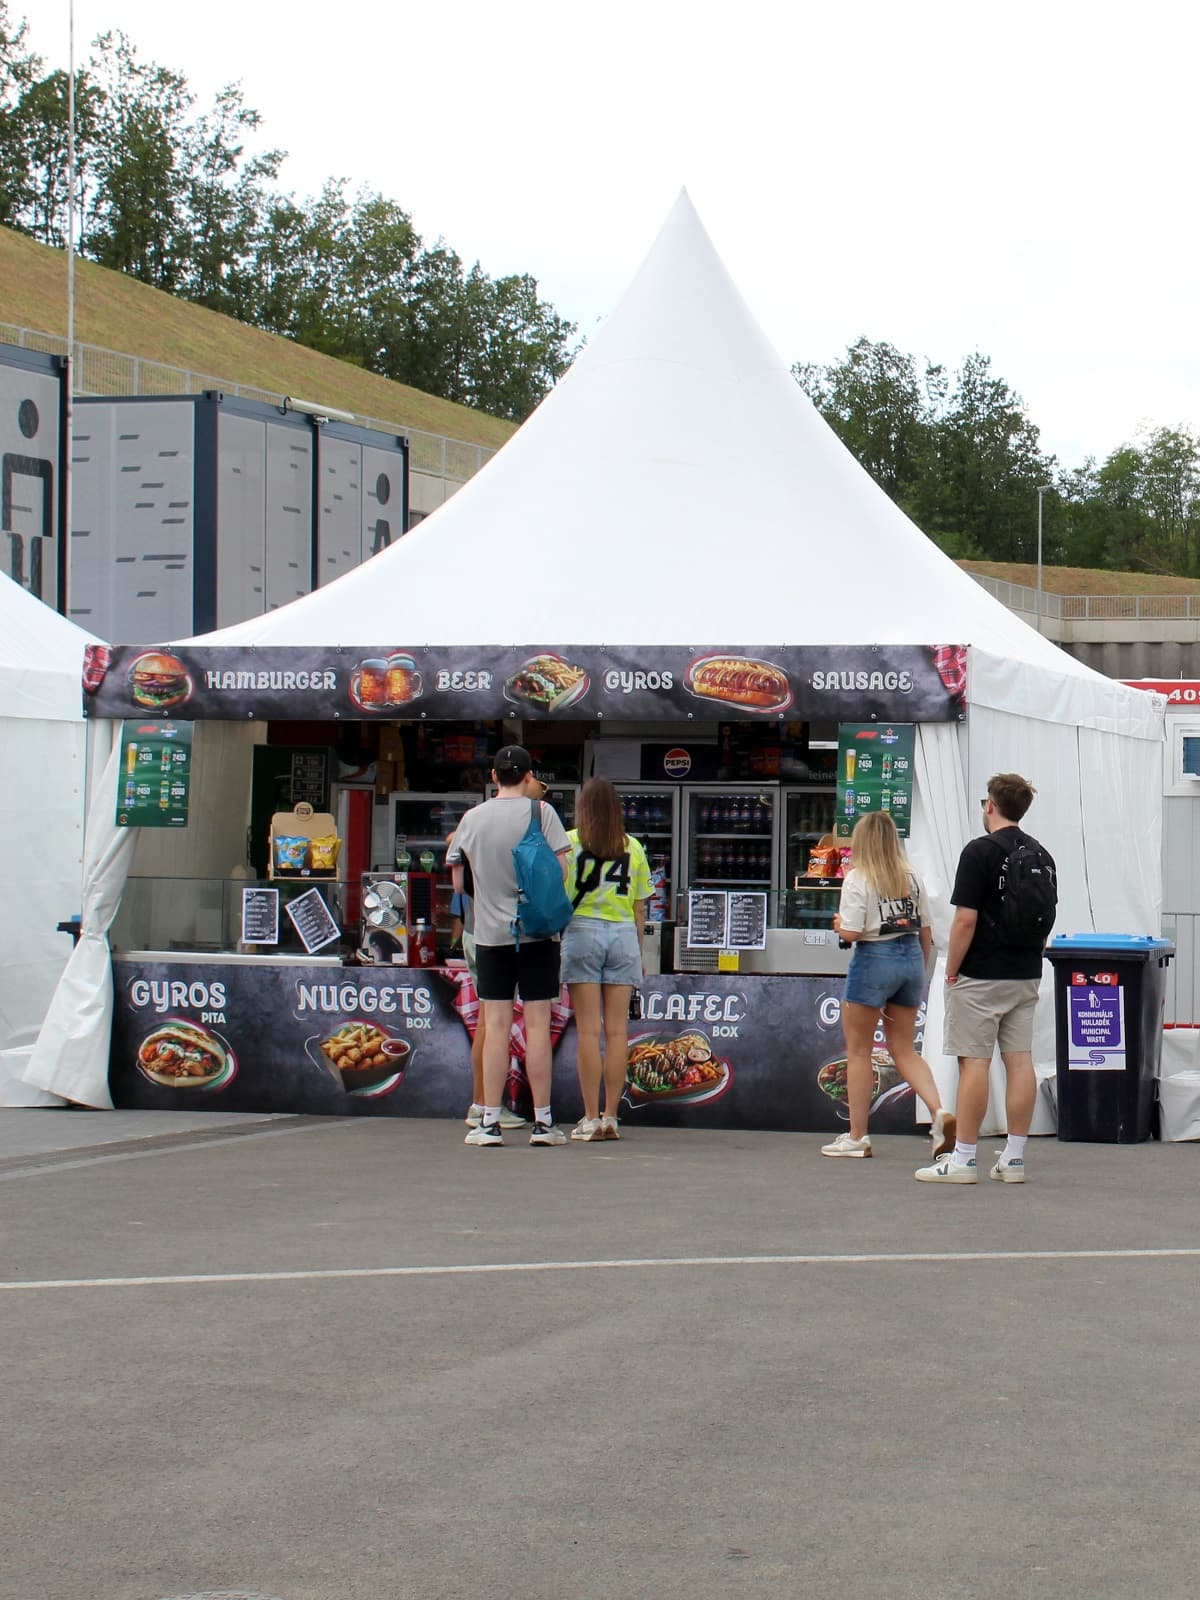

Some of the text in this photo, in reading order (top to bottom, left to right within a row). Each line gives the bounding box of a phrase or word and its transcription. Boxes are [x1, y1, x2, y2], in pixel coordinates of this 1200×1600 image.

[206, 670, 336, 690] HAMBURGER
[438, 670, 492, 690] BEER
[605, 671, 673, 693] GYROS
[812, 671, 911, 690] SAUSAGE
[665, 758, 690, 767] PEPSI
[131, 980, 227, 1013] GYROS
[298, 984, 433, 1014] NUGGETS
[640, 992, 741, 1022] LAFEL
[201, 1012, 227, 1024] PITA
[406, 1017, 433, 1030] BOX
[712, 1026, 739, 1038] BOX
